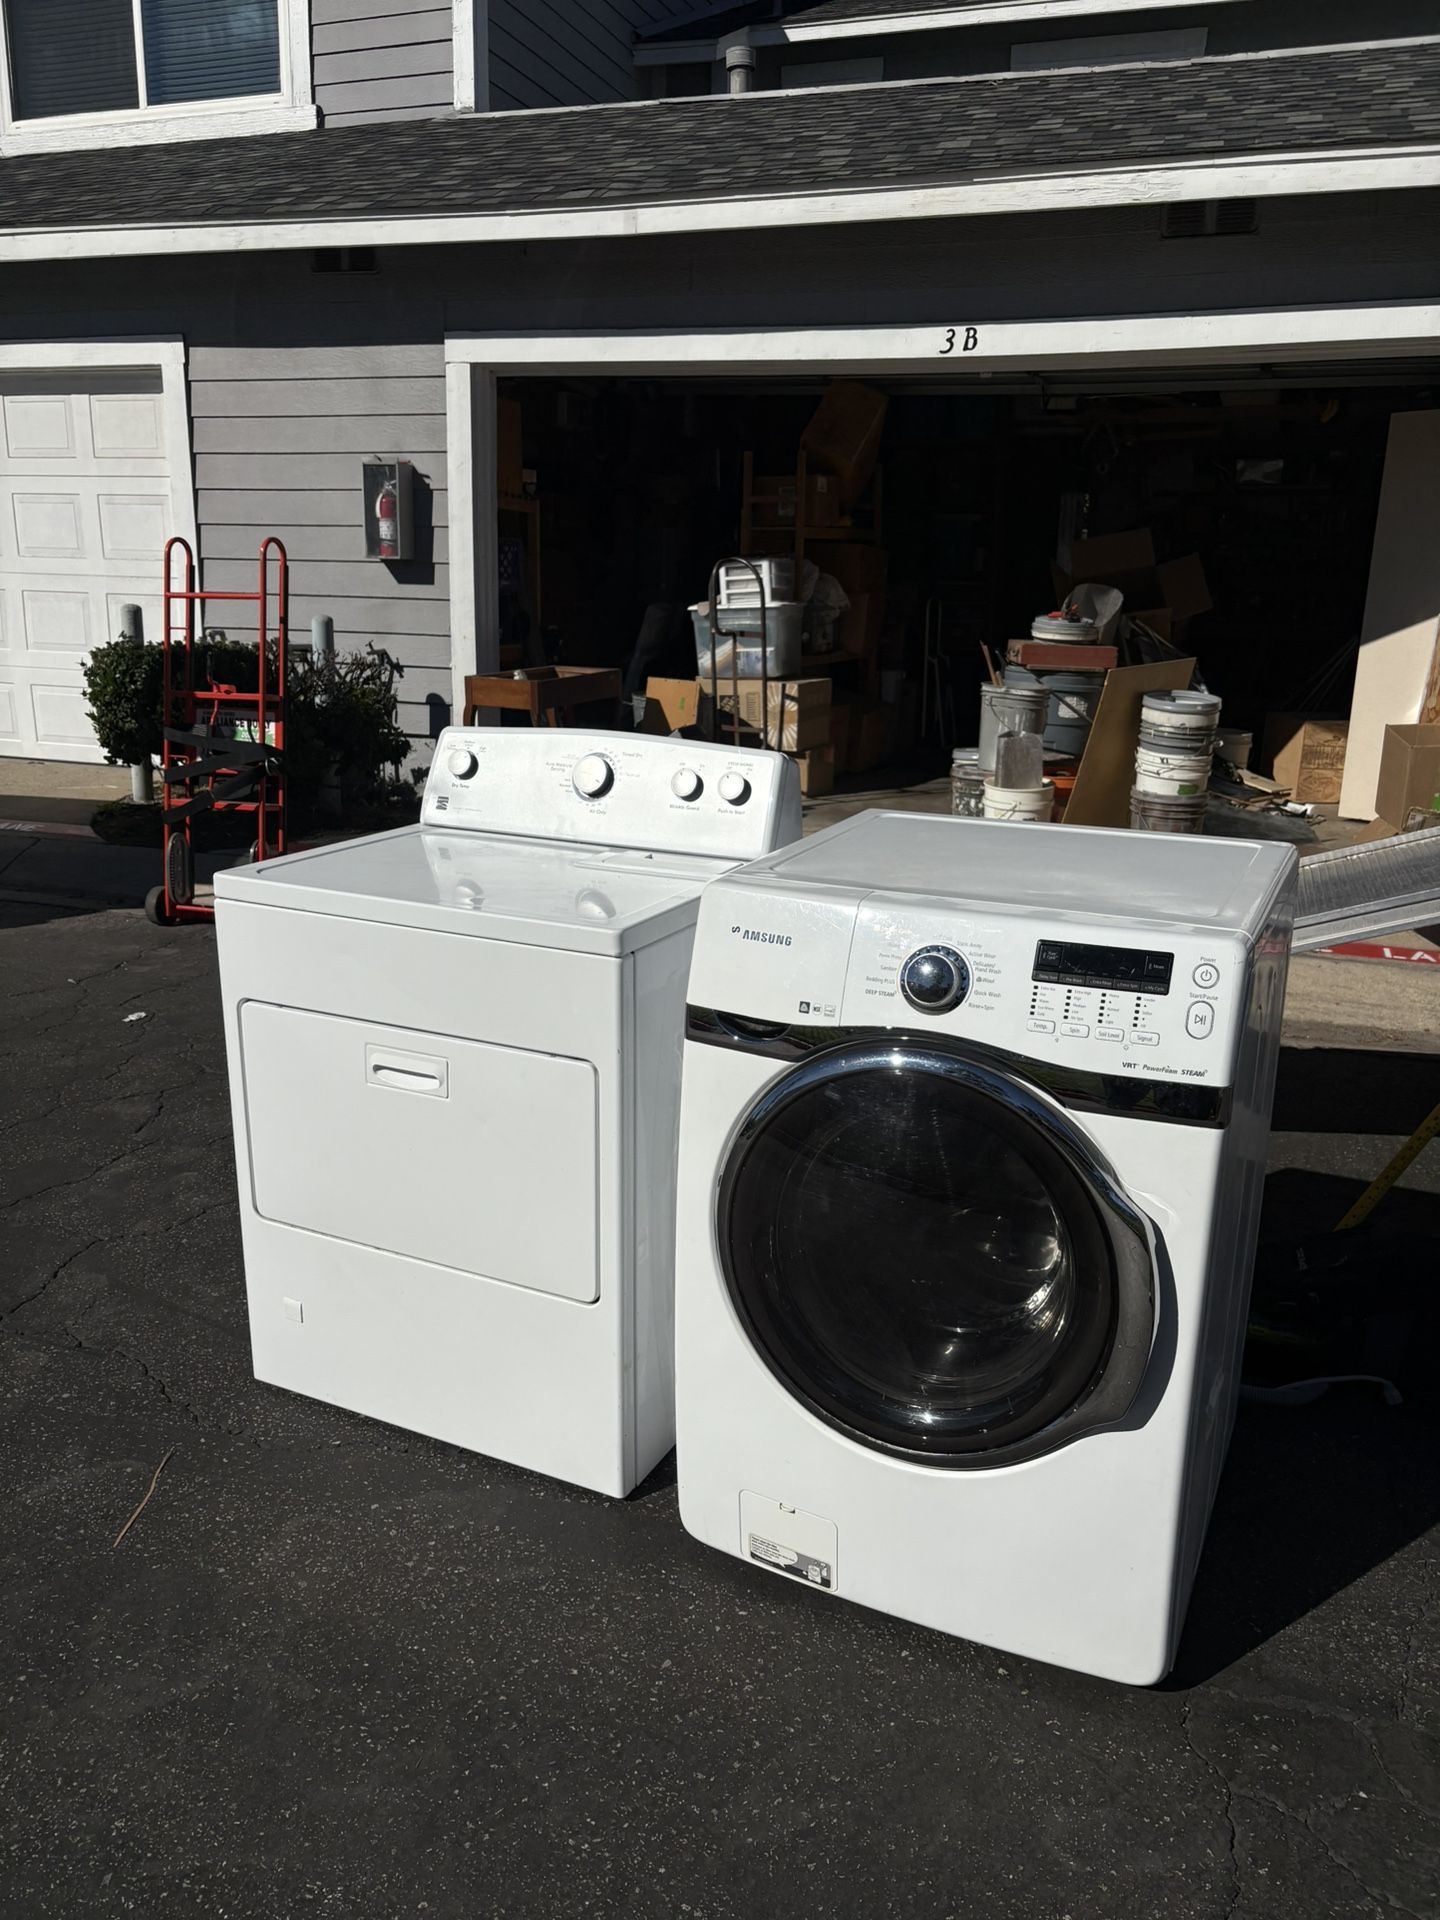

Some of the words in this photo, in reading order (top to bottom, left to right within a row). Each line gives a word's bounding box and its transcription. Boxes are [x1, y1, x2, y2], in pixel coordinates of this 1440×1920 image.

[201, 716, 245, 728] APLIANCE
[731, 925, 793, 947] SAMSUNG
[1383, 947, 1440, 962] LA
[989, 967, 1002, 975] Wash
[988, 991, 1002, 999] Wash
[1189, 991, 1219, 1001] Start/Pause
[1069, 1026, 1080, 1034] Spin
[1137, 1034, 1153, 1042] Signal
[1142, 1064, 1178, 1075] PowerFoam
